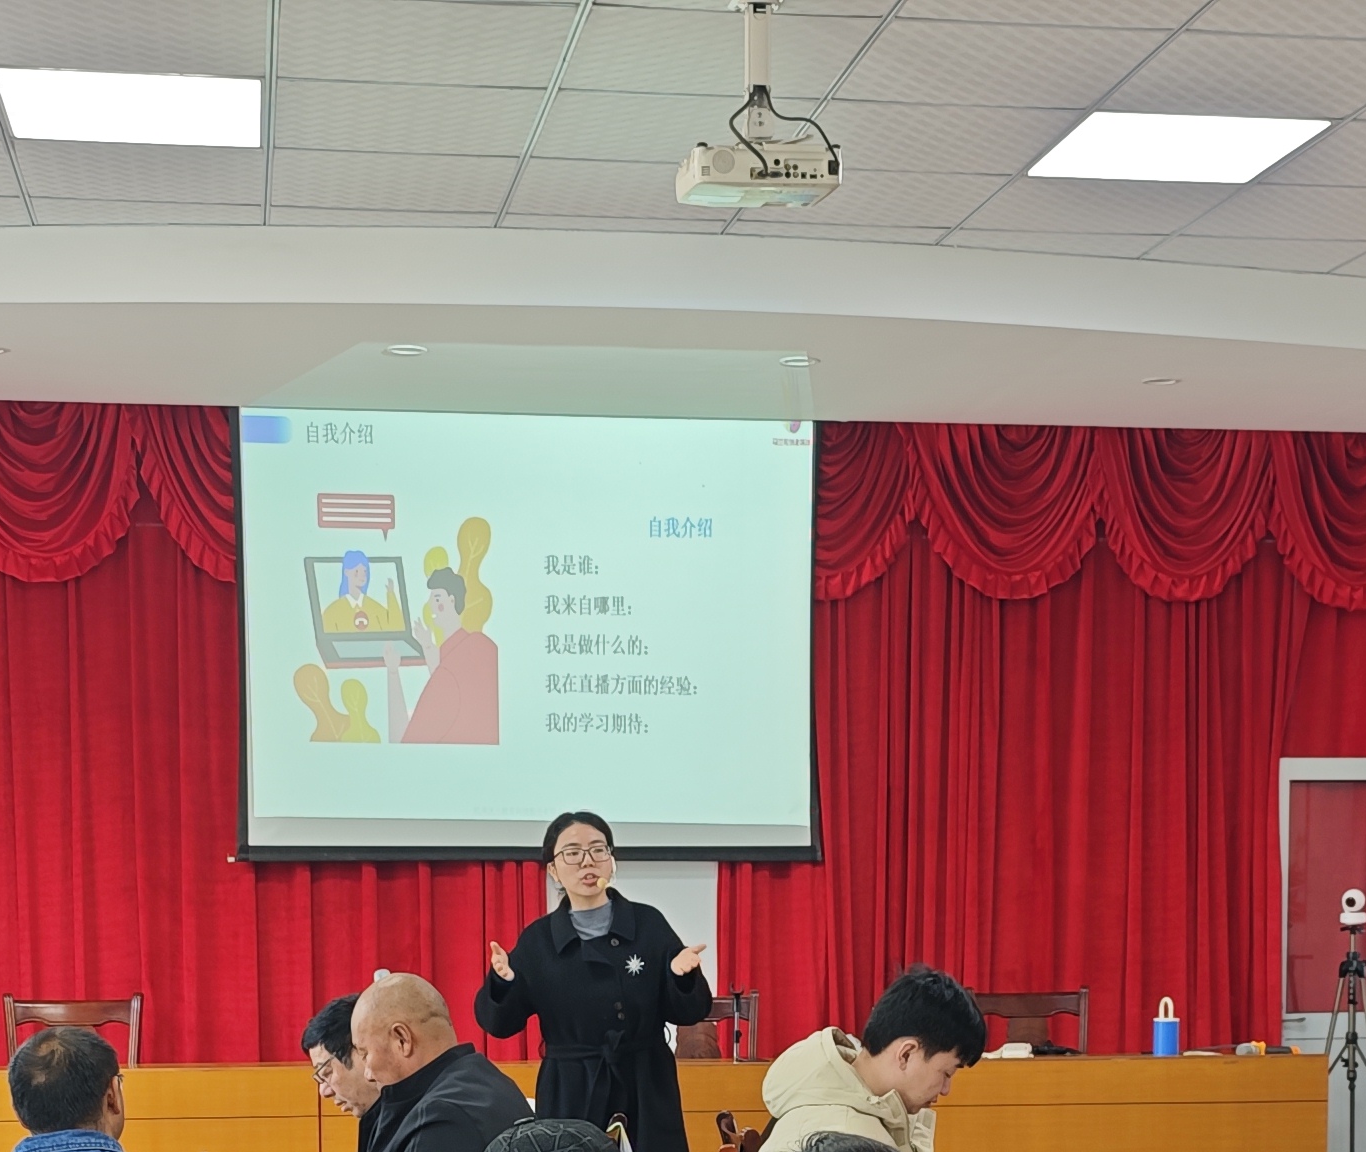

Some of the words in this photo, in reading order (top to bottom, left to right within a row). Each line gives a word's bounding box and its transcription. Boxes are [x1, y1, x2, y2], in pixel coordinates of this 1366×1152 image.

[304, 421, 375, 446] 自我介绍
[648, 515, 714, 540] 自我介绍
